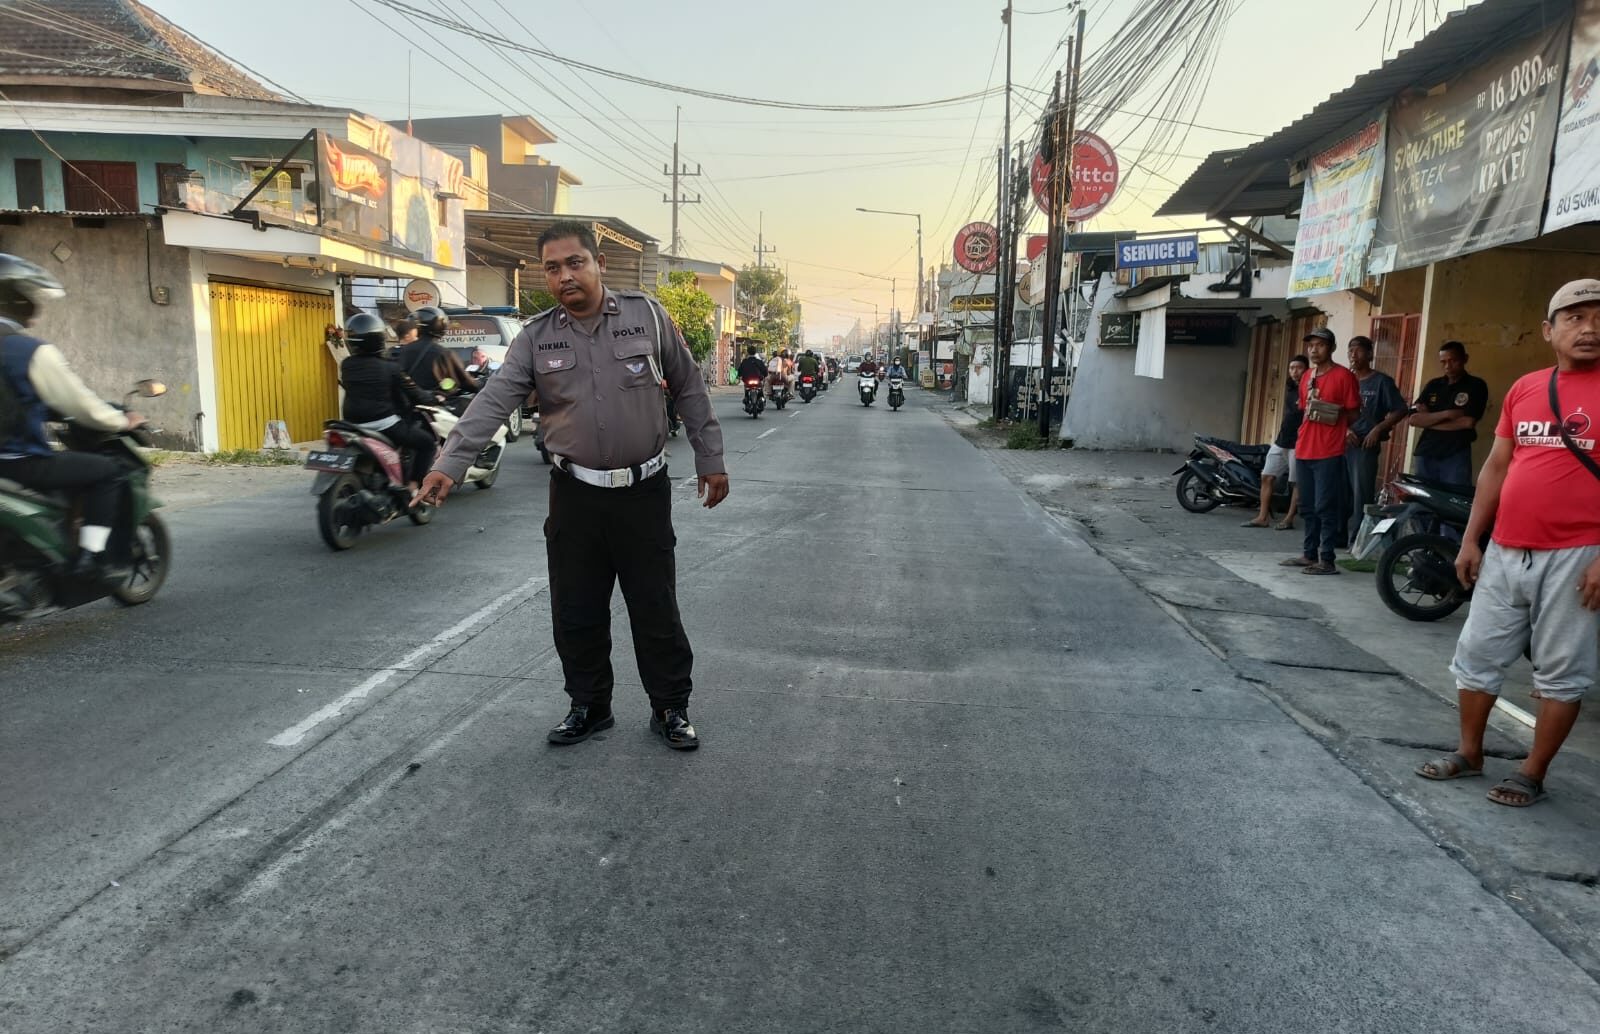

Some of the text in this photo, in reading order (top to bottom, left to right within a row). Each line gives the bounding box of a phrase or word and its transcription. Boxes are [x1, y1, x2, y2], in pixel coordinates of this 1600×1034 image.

[1477, 91, 1486, 110] RP
[1395, 120, 1465, 172] SIGNATURE
[1401, 162, 1446, 196] KRETEK
[1122, 240, 1195, 263] SERVICE HP
[613, 326, 645, 338] POLRI
[1516, 421, 1551, 436] PDI
